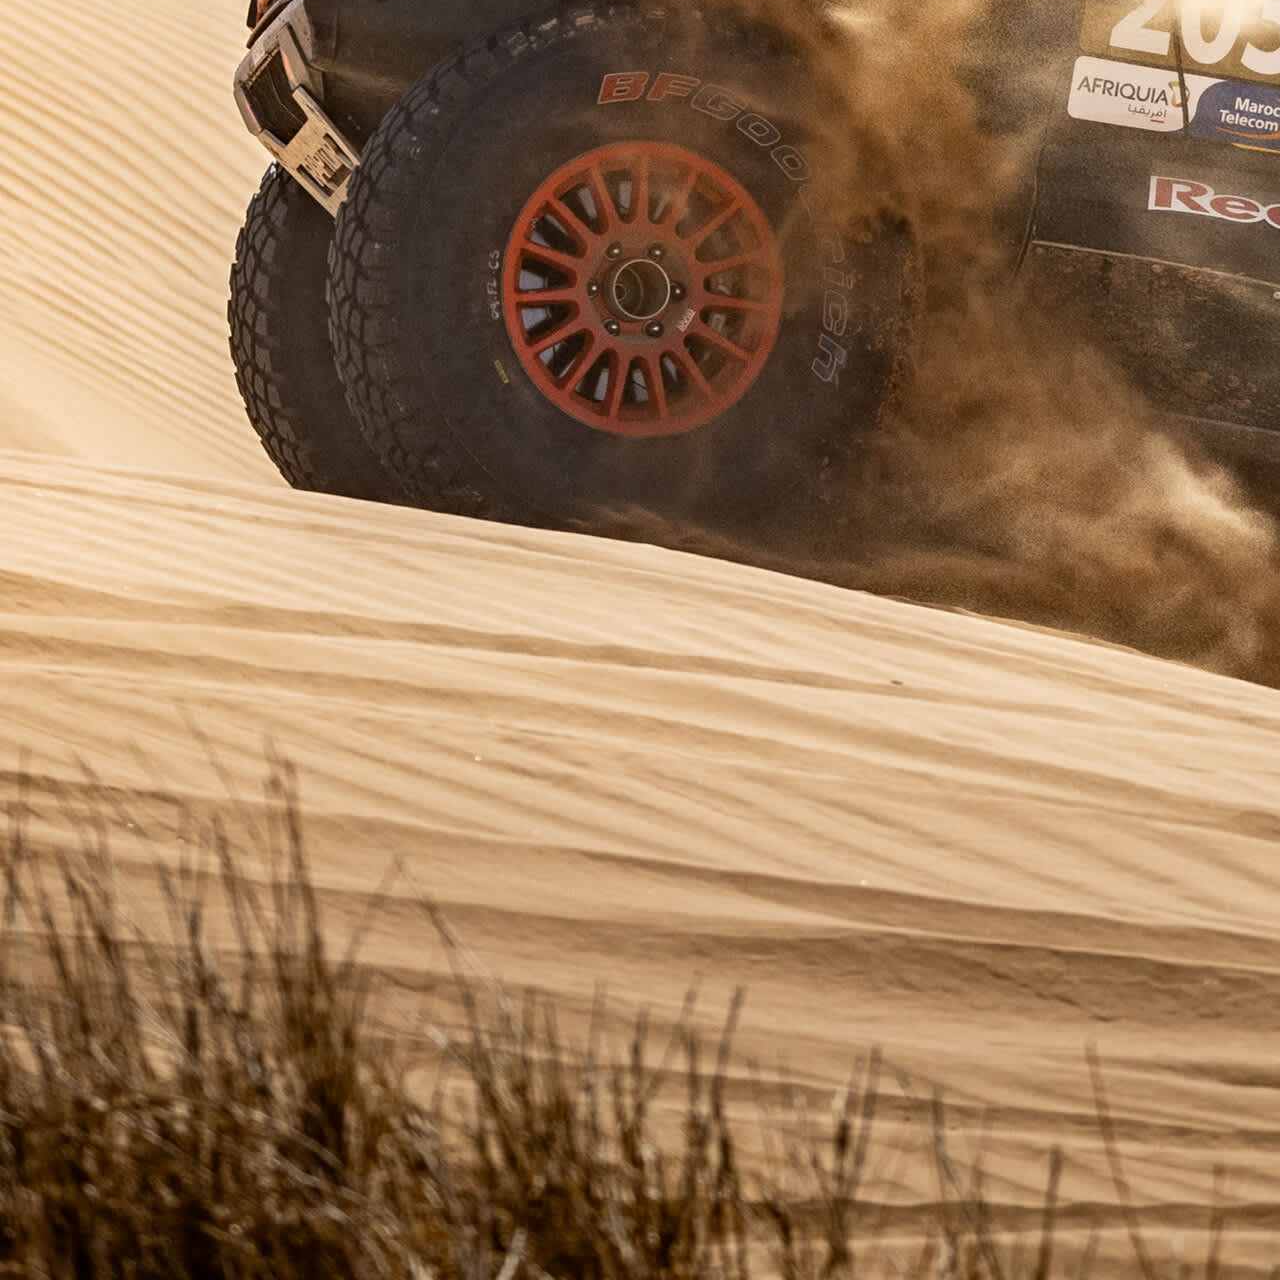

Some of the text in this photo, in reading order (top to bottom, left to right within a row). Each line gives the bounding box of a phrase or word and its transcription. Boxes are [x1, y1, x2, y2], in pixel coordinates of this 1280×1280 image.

[1077, 75, 1169, 107] AFRIQUIA
[1234, 96, 1280, 118] Maroc
[1219, 109, 1280, 132] Telecom
